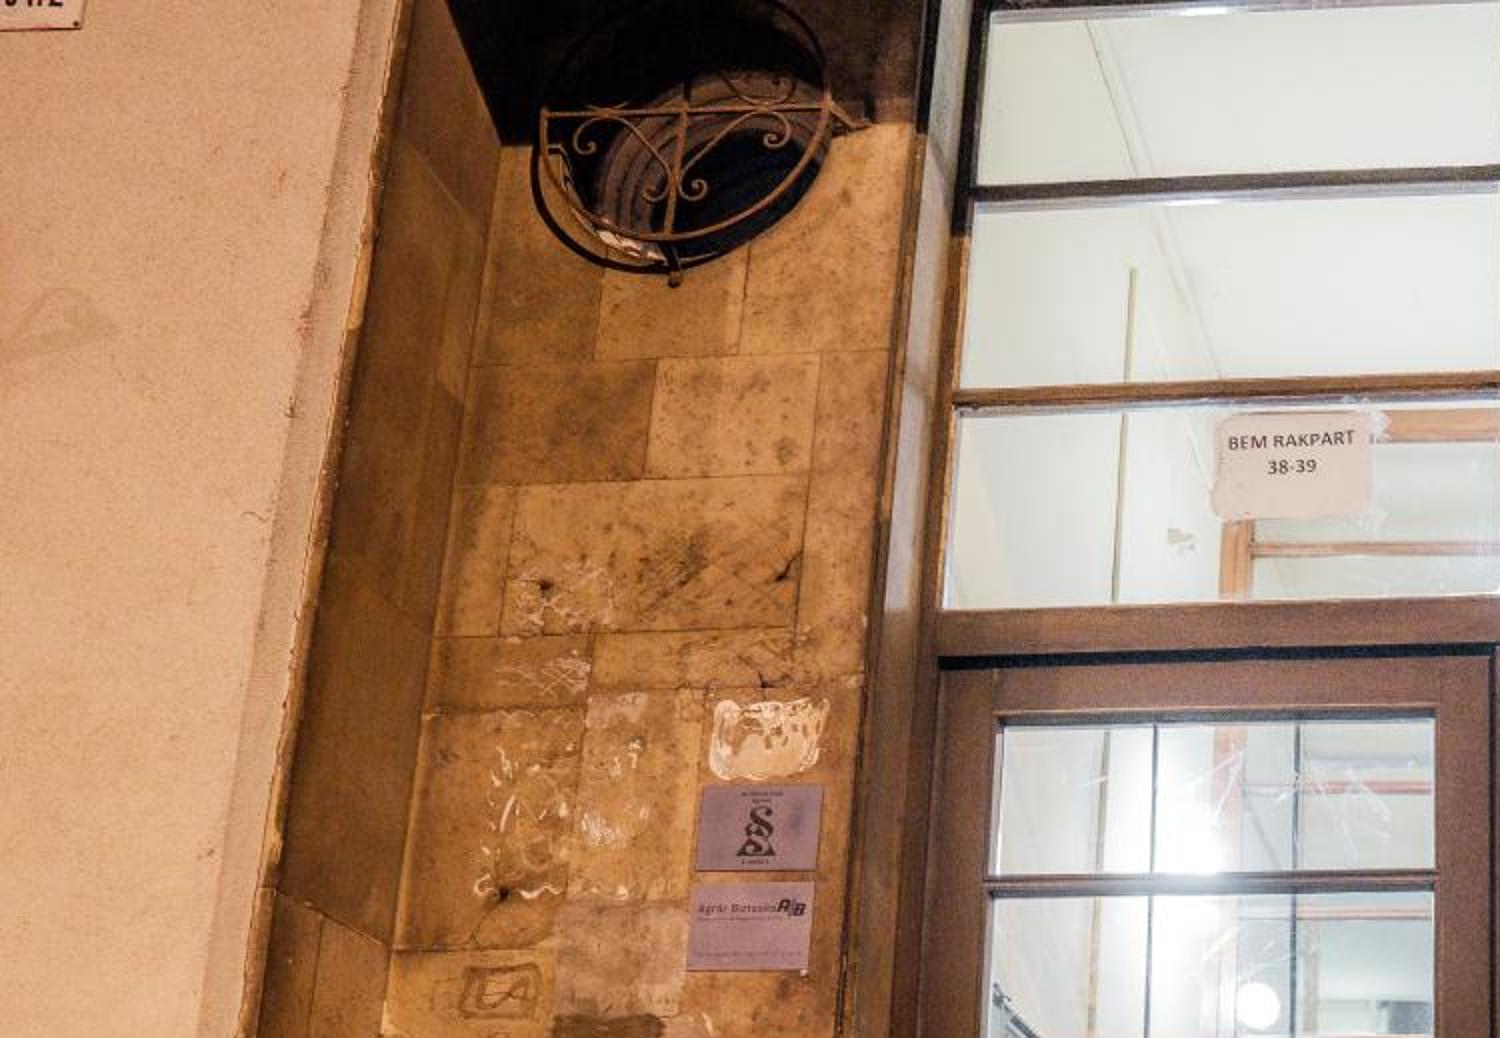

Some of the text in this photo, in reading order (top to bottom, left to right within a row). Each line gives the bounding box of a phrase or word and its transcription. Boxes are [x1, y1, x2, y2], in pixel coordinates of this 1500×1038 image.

[1228, 430, 1355, 451] BEM RAKPART
[1267, 459, 1317, 475] 38-39
